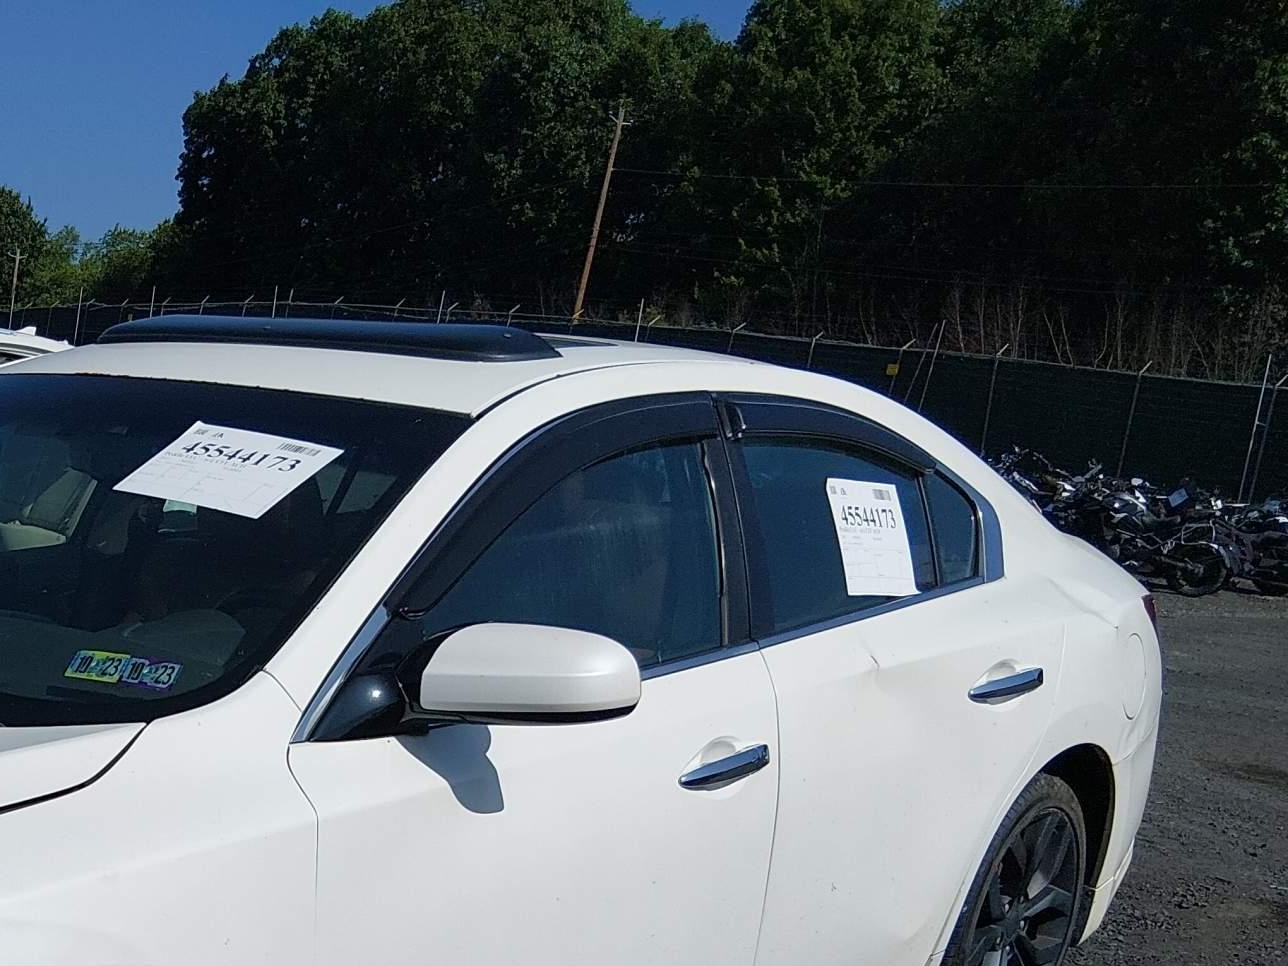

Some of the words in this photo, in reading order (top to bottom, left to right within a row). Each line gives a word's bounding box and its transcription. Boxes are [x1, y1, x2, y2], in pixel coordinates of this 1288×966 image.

[181, 441, 302, 472] 45544173
[840, 505, 897, 529] 45544173
[101, 657, 123, 677] 23
[154, 664, 176, 685] 23
